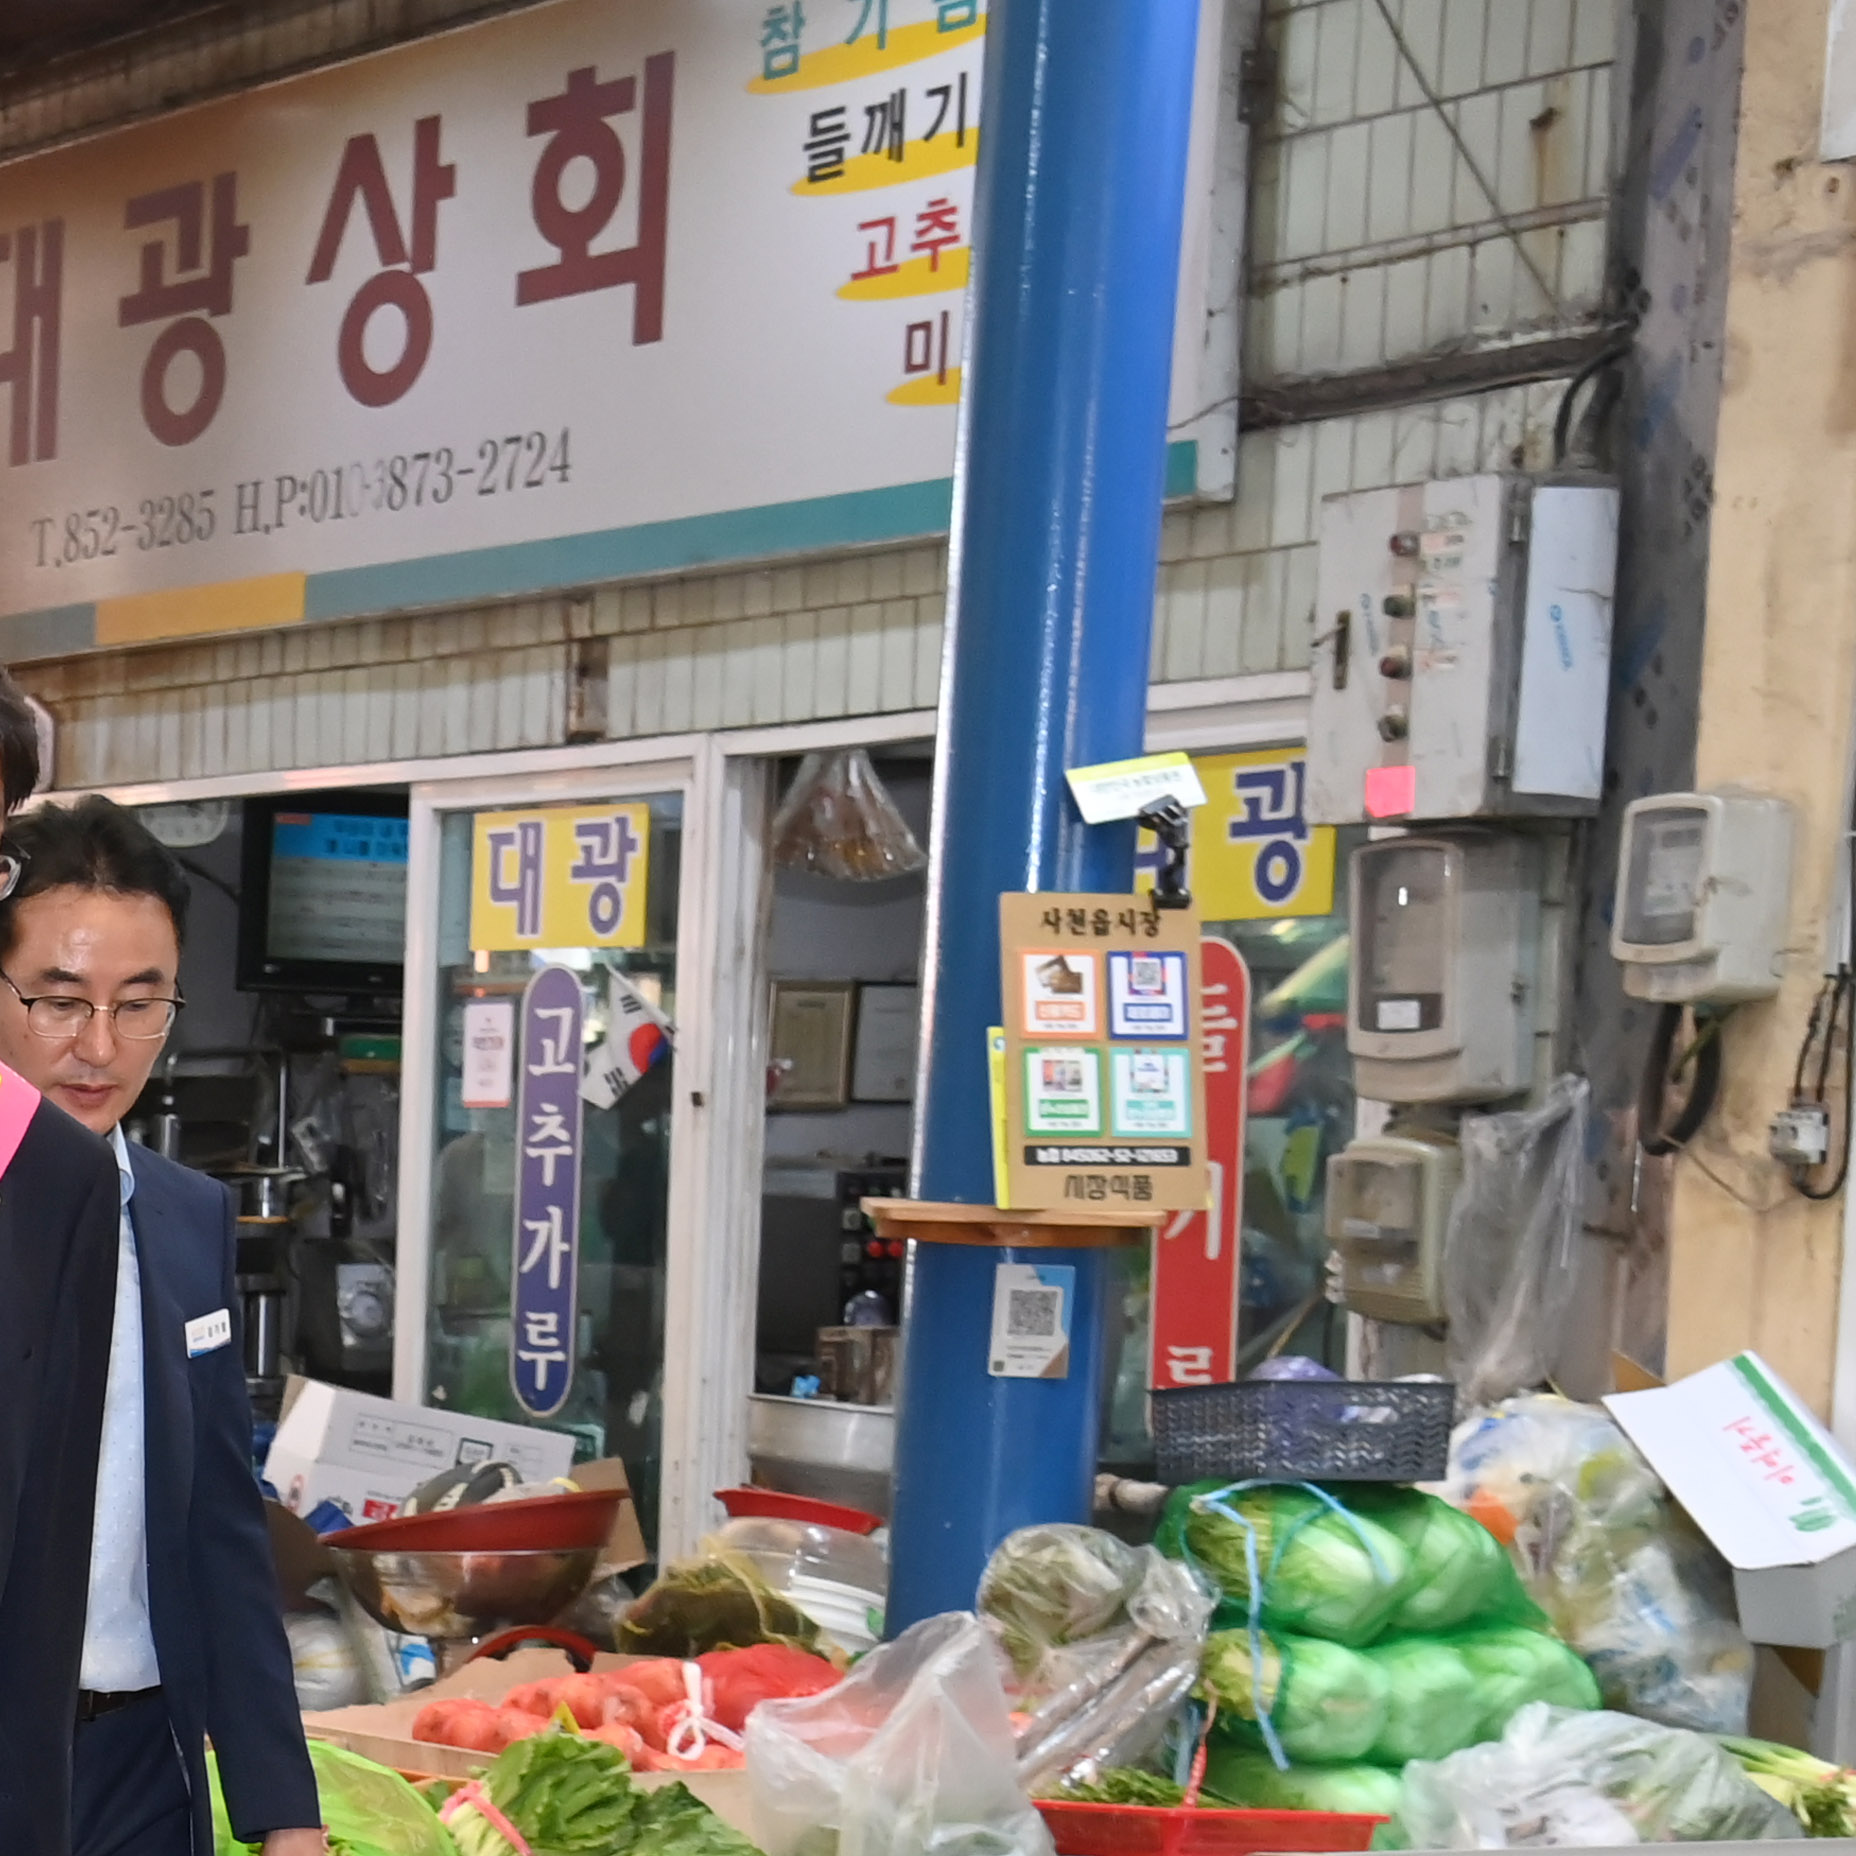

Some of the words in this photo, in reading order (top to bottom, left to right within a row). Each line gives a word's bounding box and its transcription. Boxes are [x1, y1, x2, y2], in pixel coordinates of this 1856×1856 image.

[487, 814, 638, 937] 대광
[1040, 906, 1161, 939] 사천읍시장
[517, 1005, 573, 1392] 고추가루
